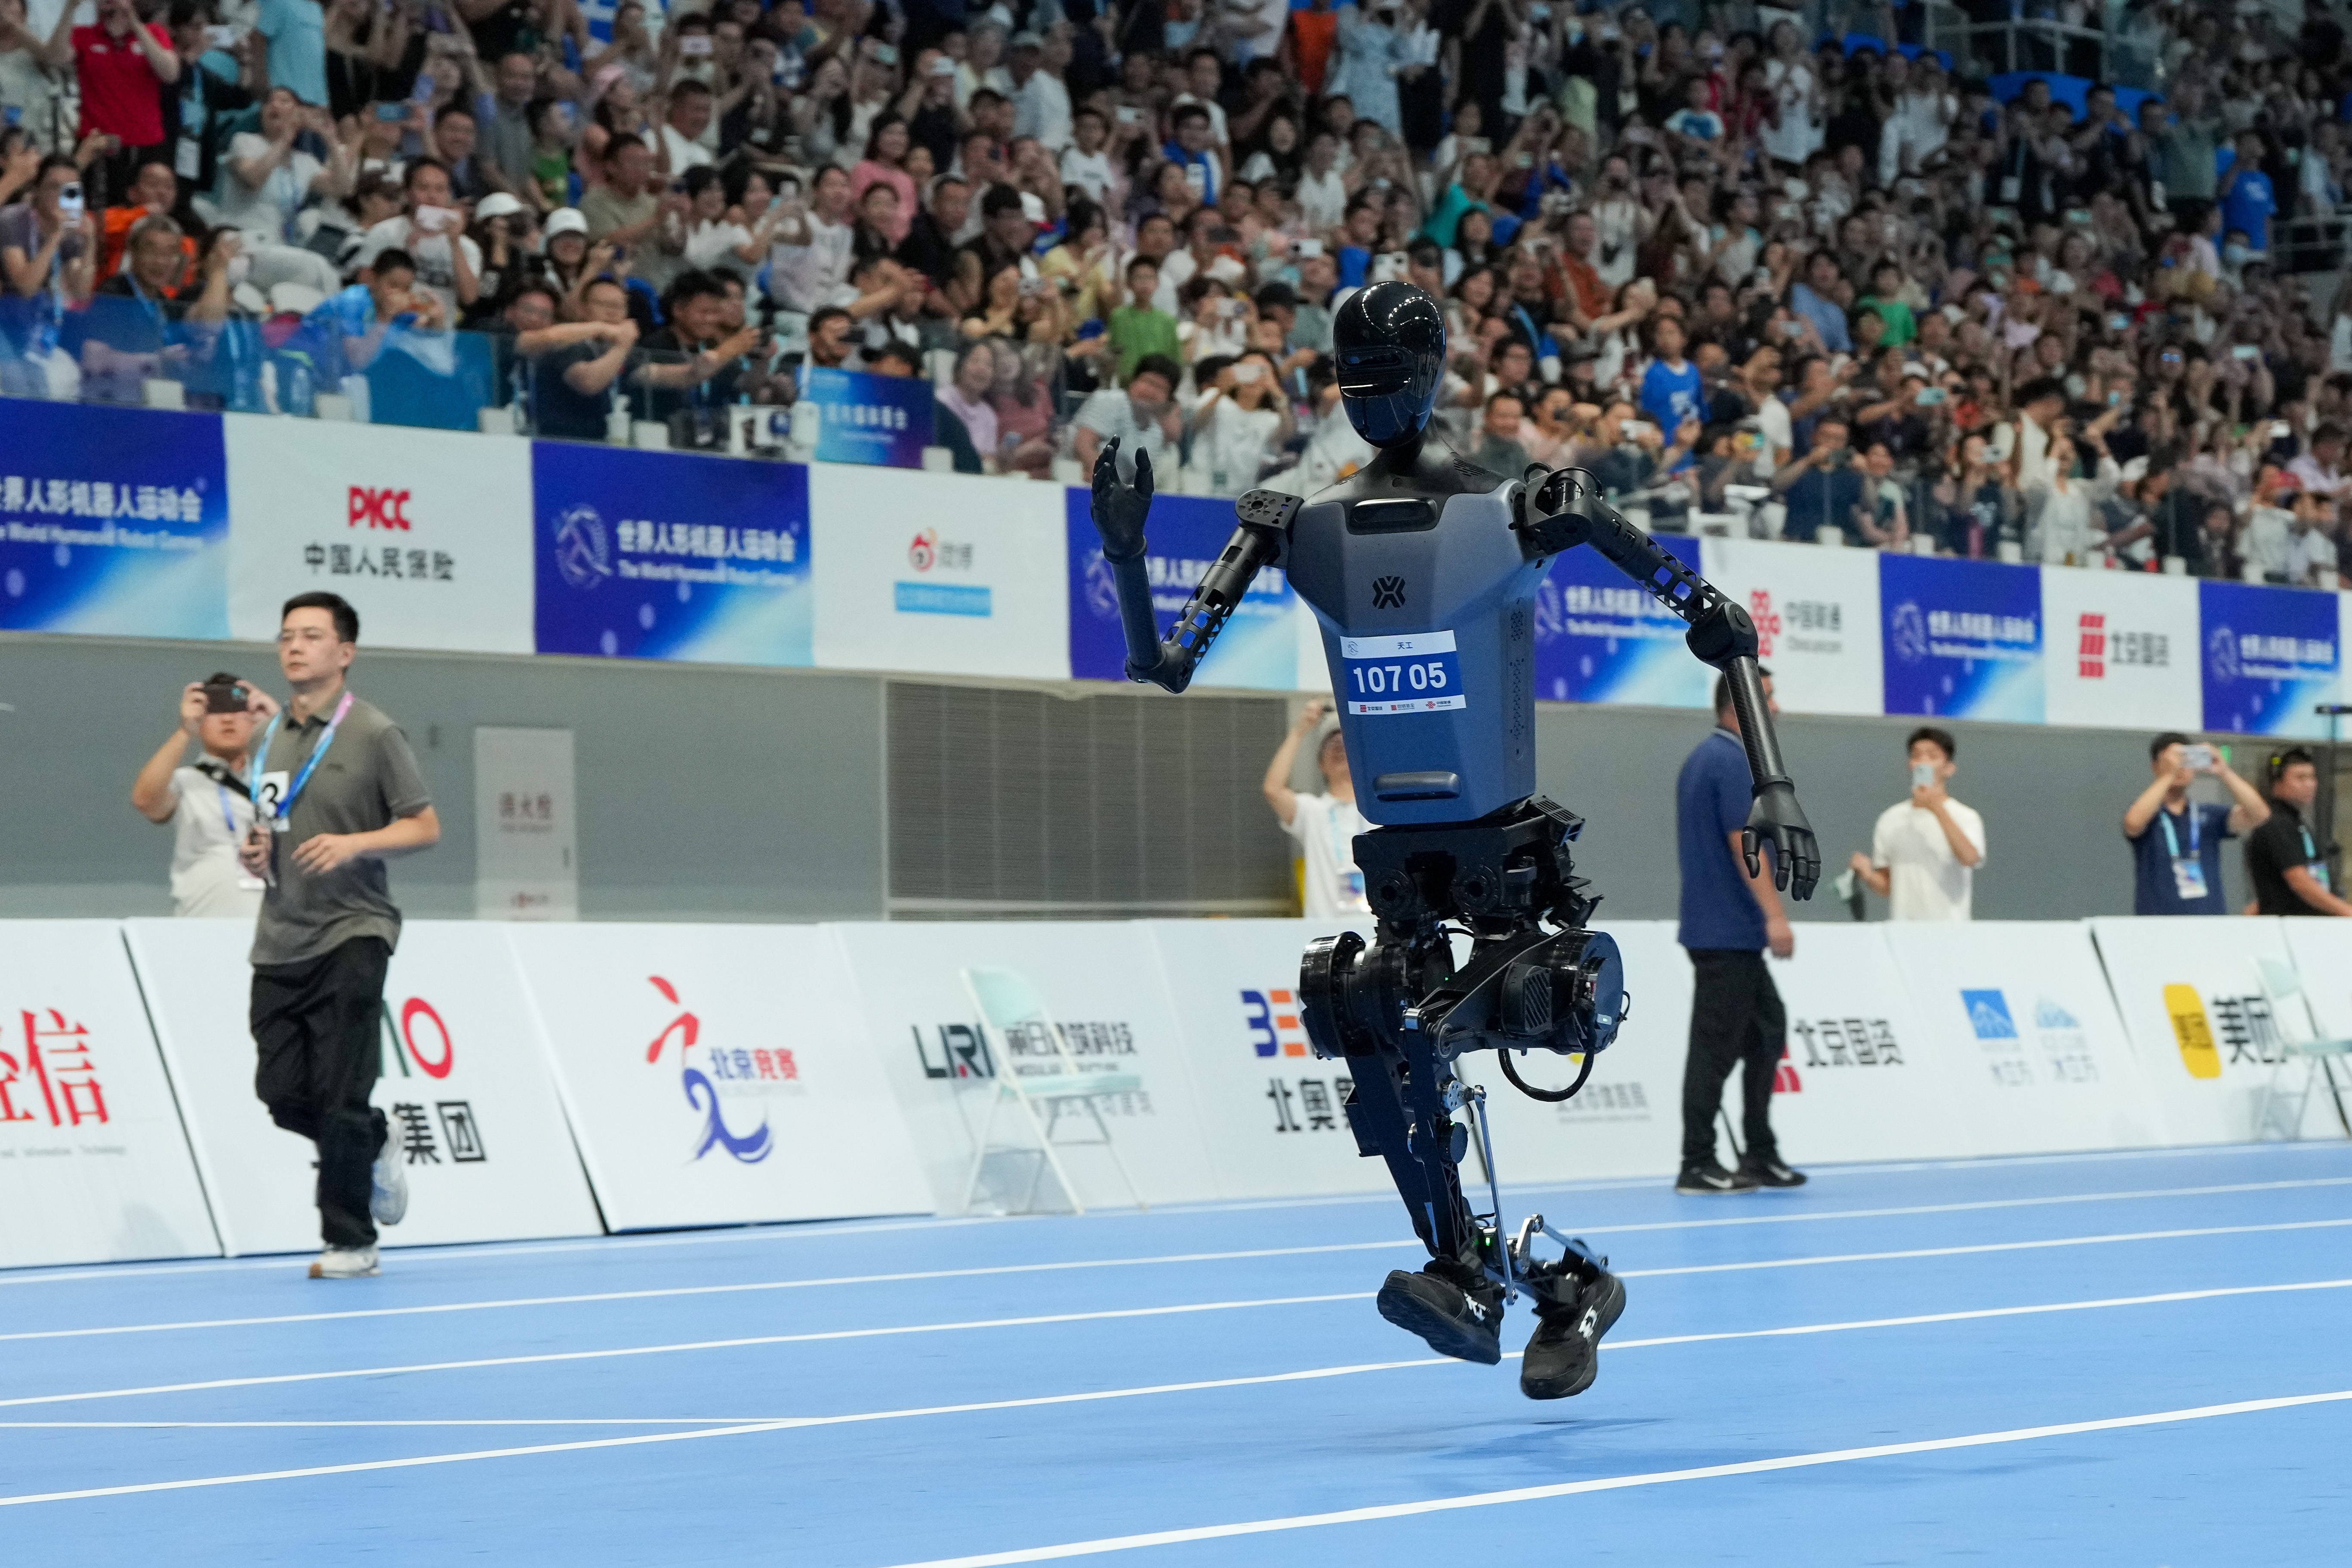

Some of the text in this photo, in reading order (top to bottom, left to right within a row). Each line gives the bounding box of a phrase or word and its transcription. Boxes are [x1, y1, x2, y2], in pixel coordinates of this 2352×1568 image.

[0, 475, 203, 523] 界人形机器人运动会
[348, 486, 411, 531] PICC
[304, 541, 454, 581] 中国人民保险
[1397, 642, 1413, 650] 天工
[394, 1100, 487, 1164] 集团
